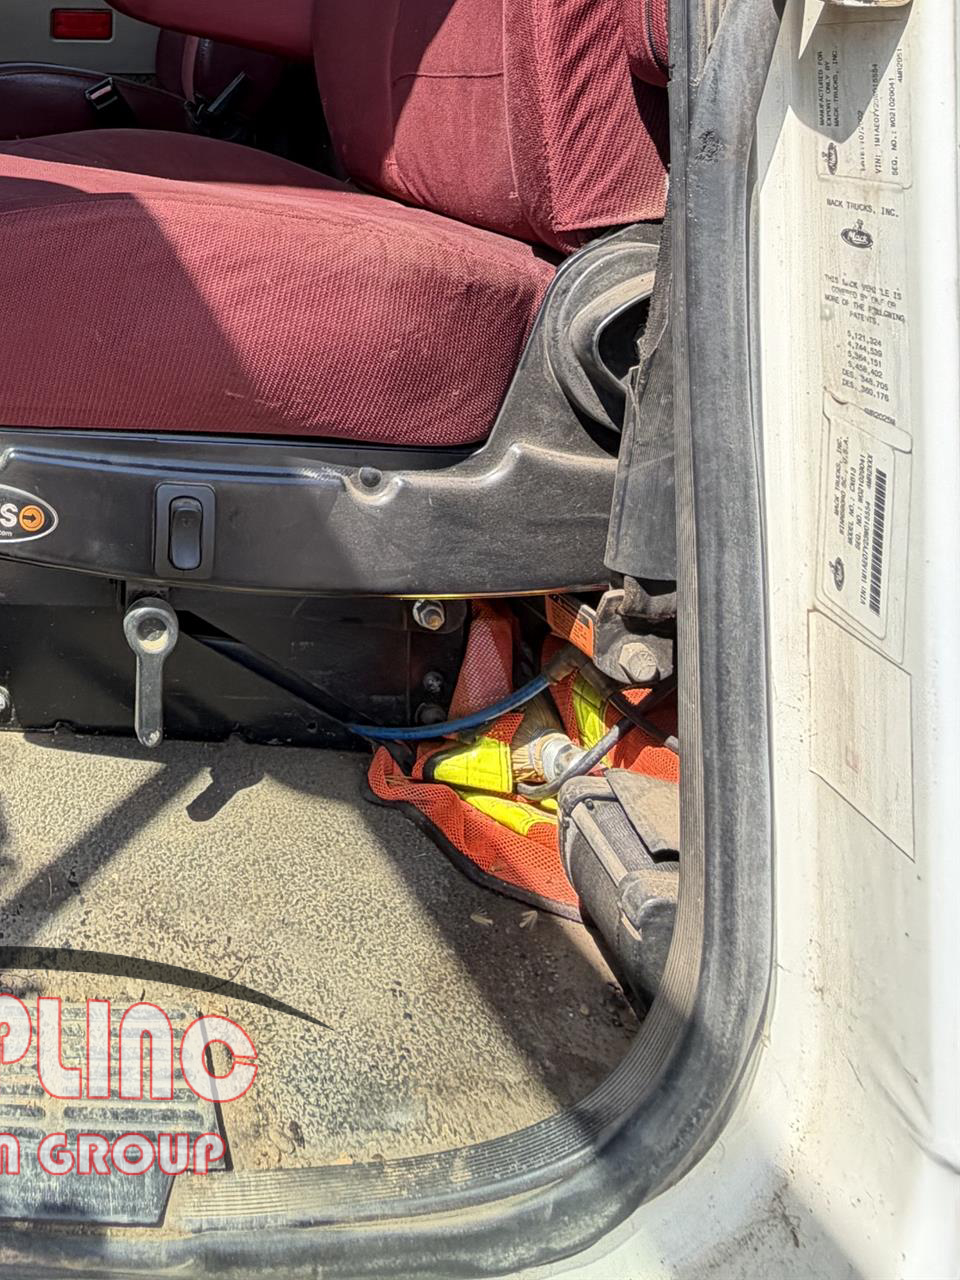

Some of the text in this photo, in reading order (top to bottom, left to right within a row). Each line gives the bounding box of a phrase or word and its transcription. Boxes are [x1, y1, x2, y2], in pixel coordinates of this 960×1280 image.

[817, 69, 825, 126] MANUFACTURED
[826, 198, 844, 209] MACK
[880, 206, 899, 218] INC.
